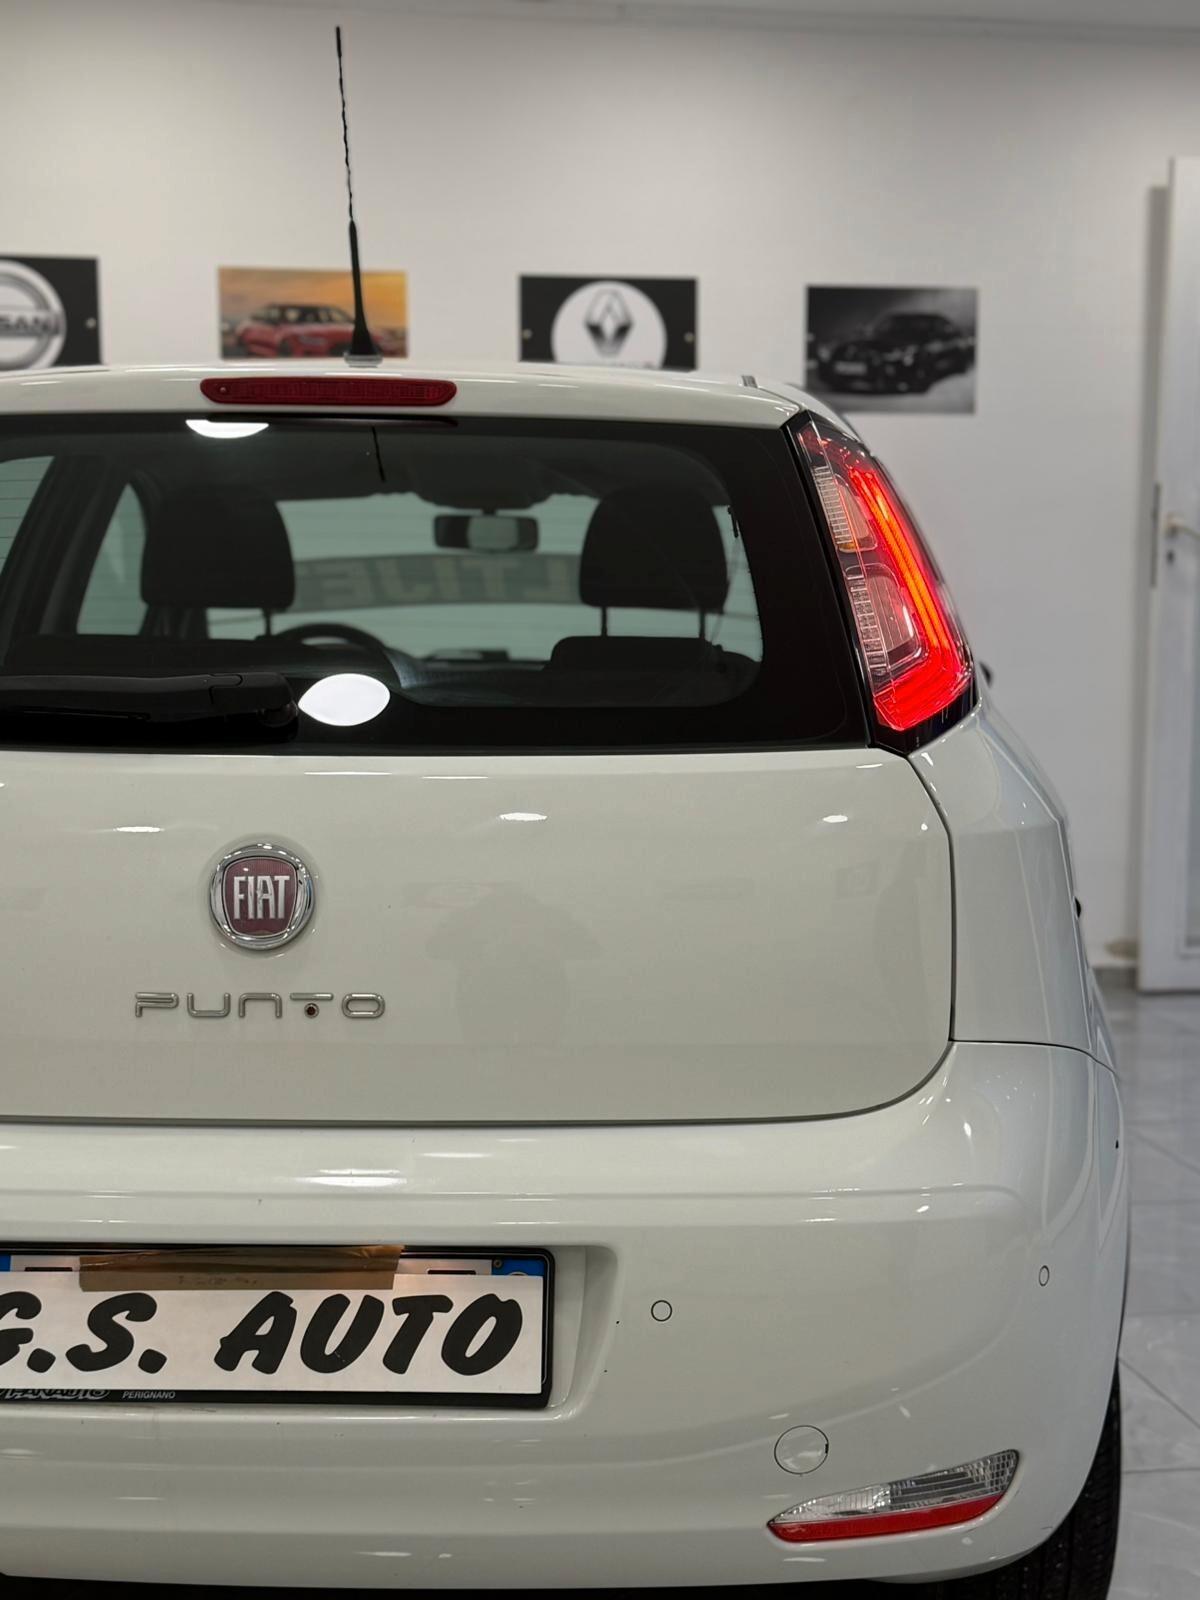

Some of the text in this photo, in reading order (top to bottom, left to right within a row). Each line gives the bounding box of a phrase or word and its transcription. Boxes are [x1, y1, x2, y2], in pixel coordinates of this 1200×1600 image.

[233, 875, 290, 919] FIAT
[134, 991, 386, 1018] PUNTO
[214, 1291, 523, 1376] AUTO
[122, 1390, 176, 1400] PERIGNANO
